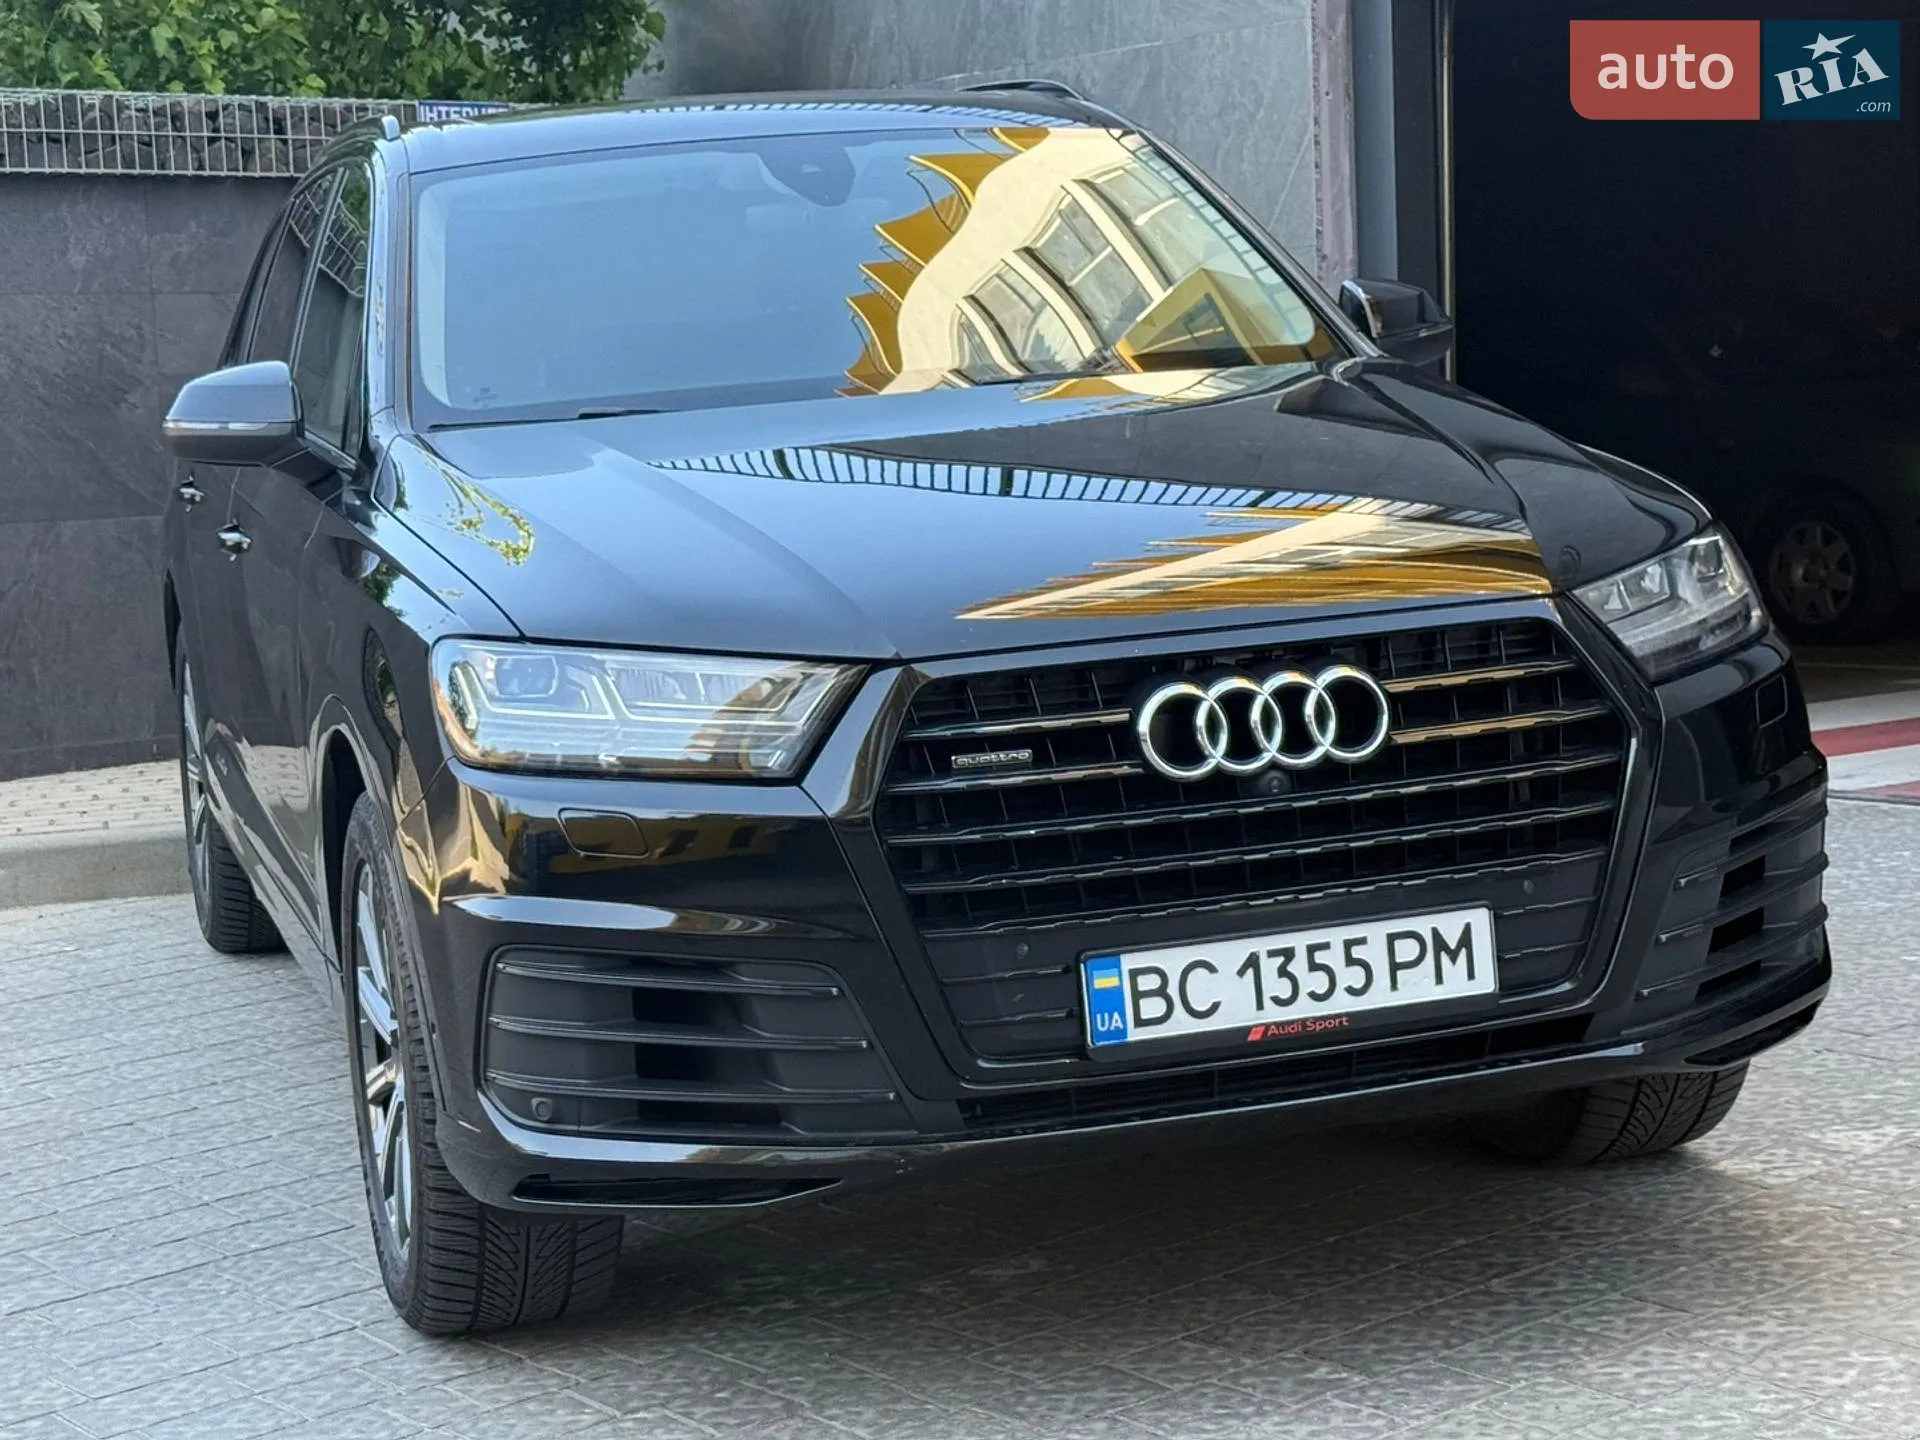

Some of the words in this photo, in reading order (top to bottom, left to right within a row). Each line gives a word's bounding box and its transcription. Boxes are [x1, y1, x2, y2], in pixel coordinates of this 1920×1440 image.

[1236, 936, 1374, 1011] 1355
[1096, 1011, 1124, 1033] UA
[1267, 1024, 1302, 1036] Audi
[1304, 1016, 1349, 1032] Sport
